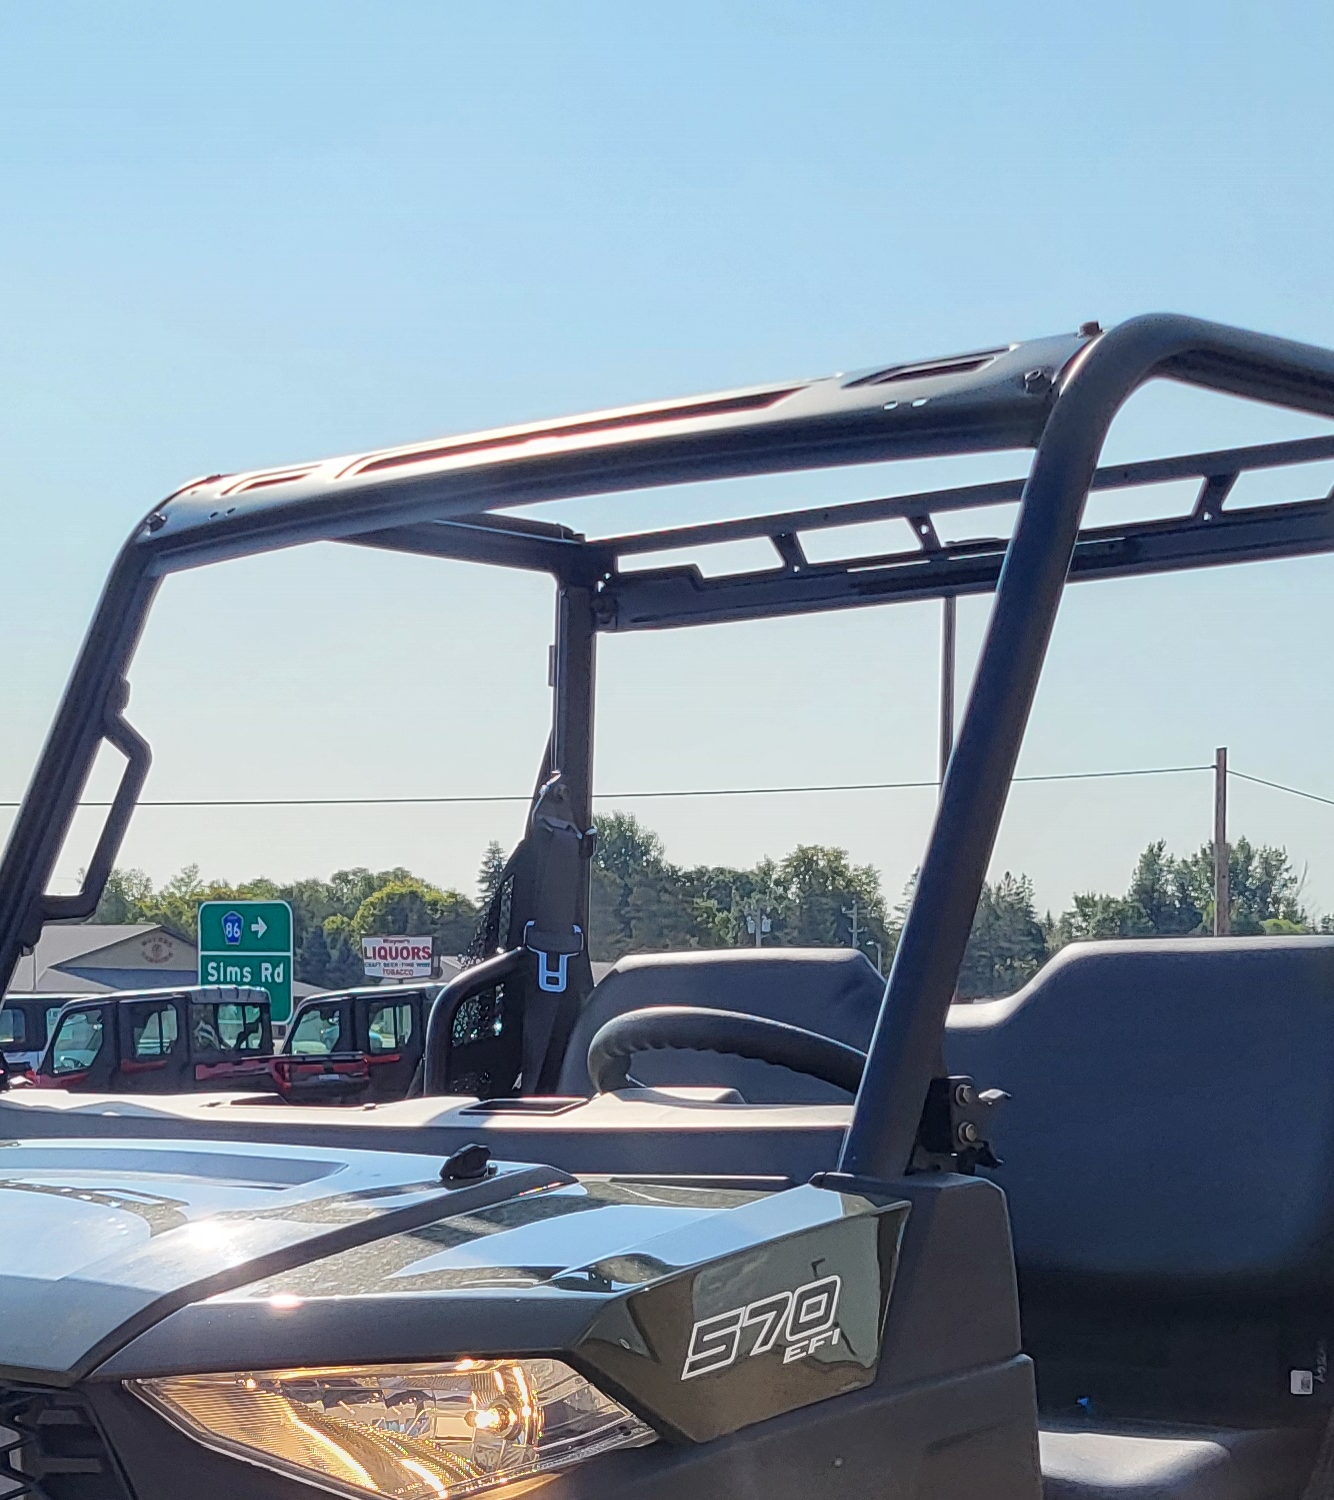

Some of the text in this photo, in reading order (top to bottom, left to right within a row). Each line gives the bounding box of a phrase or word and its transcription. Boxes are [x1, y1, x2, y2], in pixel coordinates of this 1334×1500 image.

[226, 921, 241, 938] 86
[363, 945, 432, 961] LIQUORS
[207, 961, 284, 983] Sims Rd
[680, 1274, 841, 1381] 570
[782, 1327, 841, 1364] EFI
